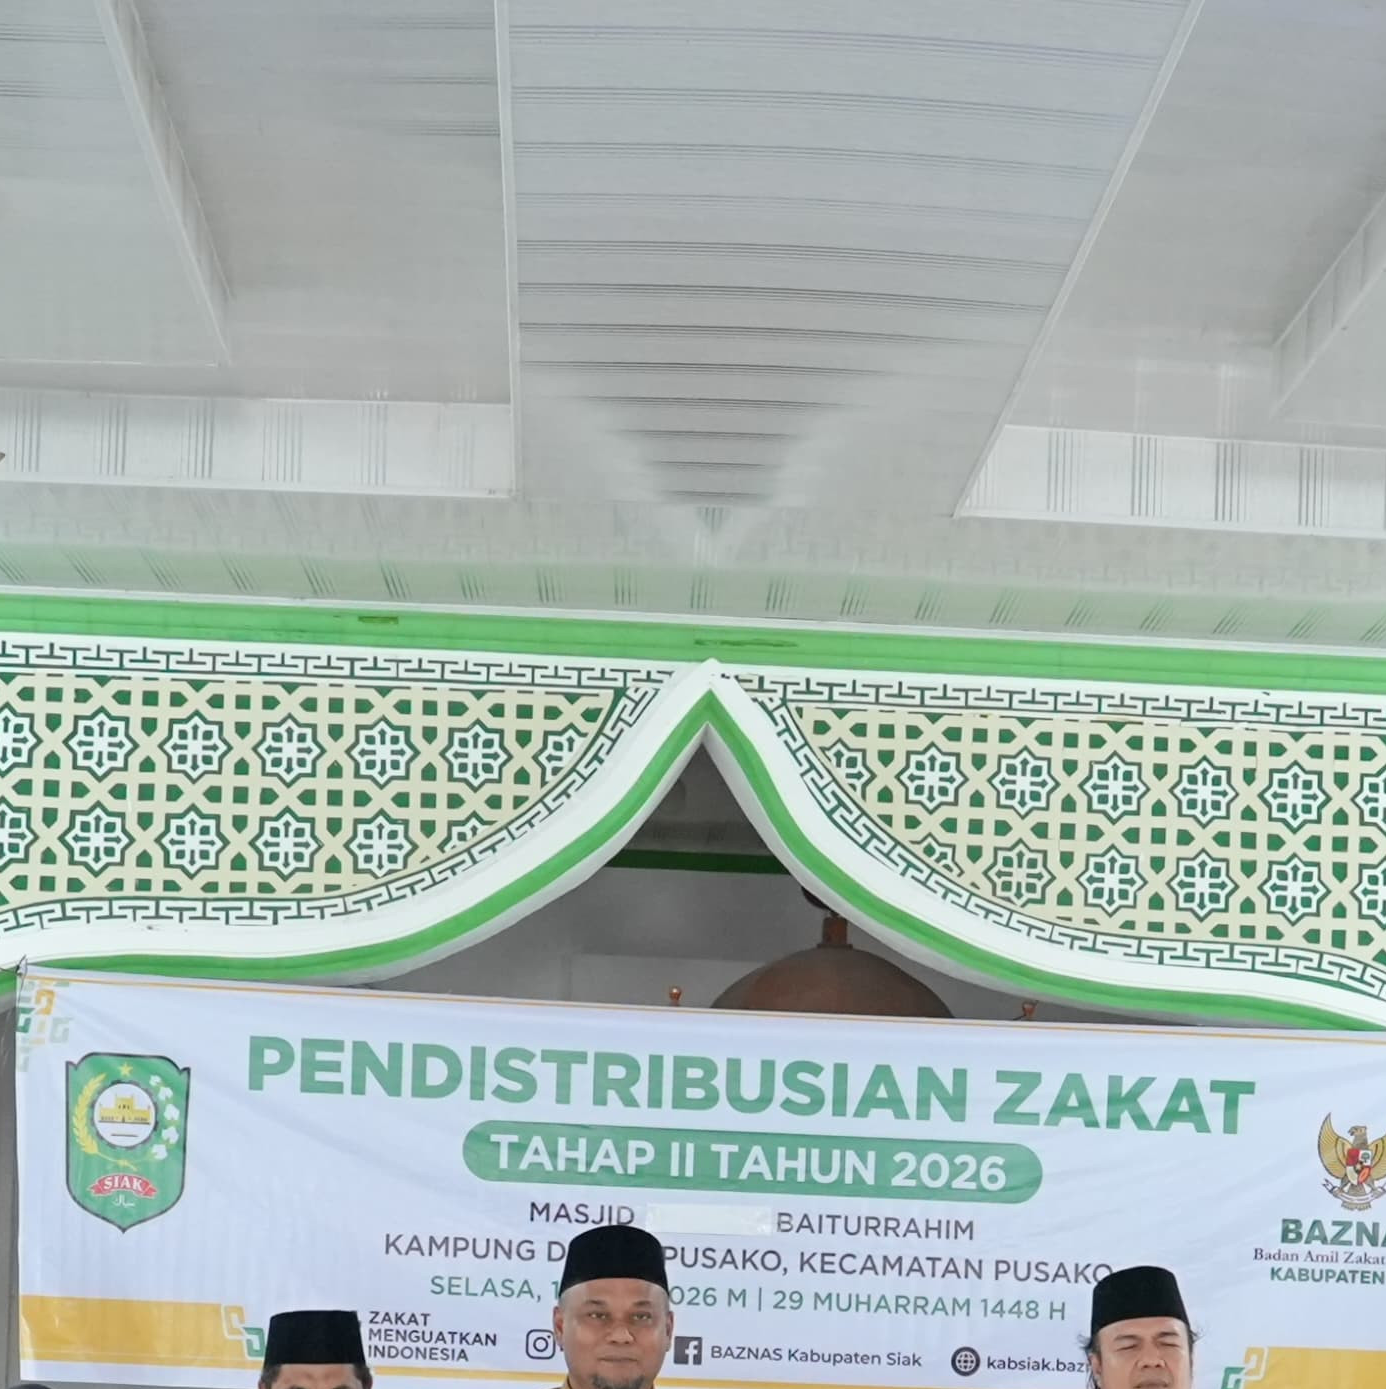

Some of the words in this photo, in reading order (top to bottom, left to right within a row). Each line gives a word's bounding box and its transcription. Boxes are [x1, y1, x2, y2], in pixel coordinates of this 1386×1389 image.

[248, 1035, 969, 1125] PENDISTRIBUSIAN
[993, 1070, 1256, 1135] ZAKAT
[489, 1133, 655, 1176] TAHAP
[671, 1139, 695, 1177] II
[710, 1142, 878, 1187] TAHUN
[892, 1151, 1006, 1192] 2026
[103, 1175, 143, 1191] SIAK
[529, 1202, 635, 1226] MASJID
[776, 1212, 974, 1241] BAITURRAHIM
[385, 1234, 536, 1262] KAMPUNG
[661, 1245, 789, 1275] PUSAKO,
[799, 1252, 983, 1281] KECAMATAN
[1253, 1247, 1299, 1262] Badan
[1303, 1251, 1339, 1264] Amil
[1343, 1252, 1385, 1266] Zakat
[1270, 1266, 1385, 1285] KABUPATEN
[430, 1276, 542, 1302] SELASA,
[669, 1286, 718, 1307] 026
[728, 1289, 747, 1308] M
[773, 1291, 804, 1310] 29
[814, 1293, 971, 1317] MUHARRAM
[981, 1298, 1040, 1320] 1448
[1049, 1301, 1065, 1321] H
[369, 1311, 431, 1327] ZAKAT
[368, 1328, 497, 1347] MENGUATKAN
[368, 1345, 469, 1362] INDONESIA
[711, 1345, 783, 1361] BAZNAS
[788, 1349, 881, 1367] Kabupaten
[887, 1352, 922, 1367] Siak
[987, 1356, 1090, 1373] kabsiak.baz
